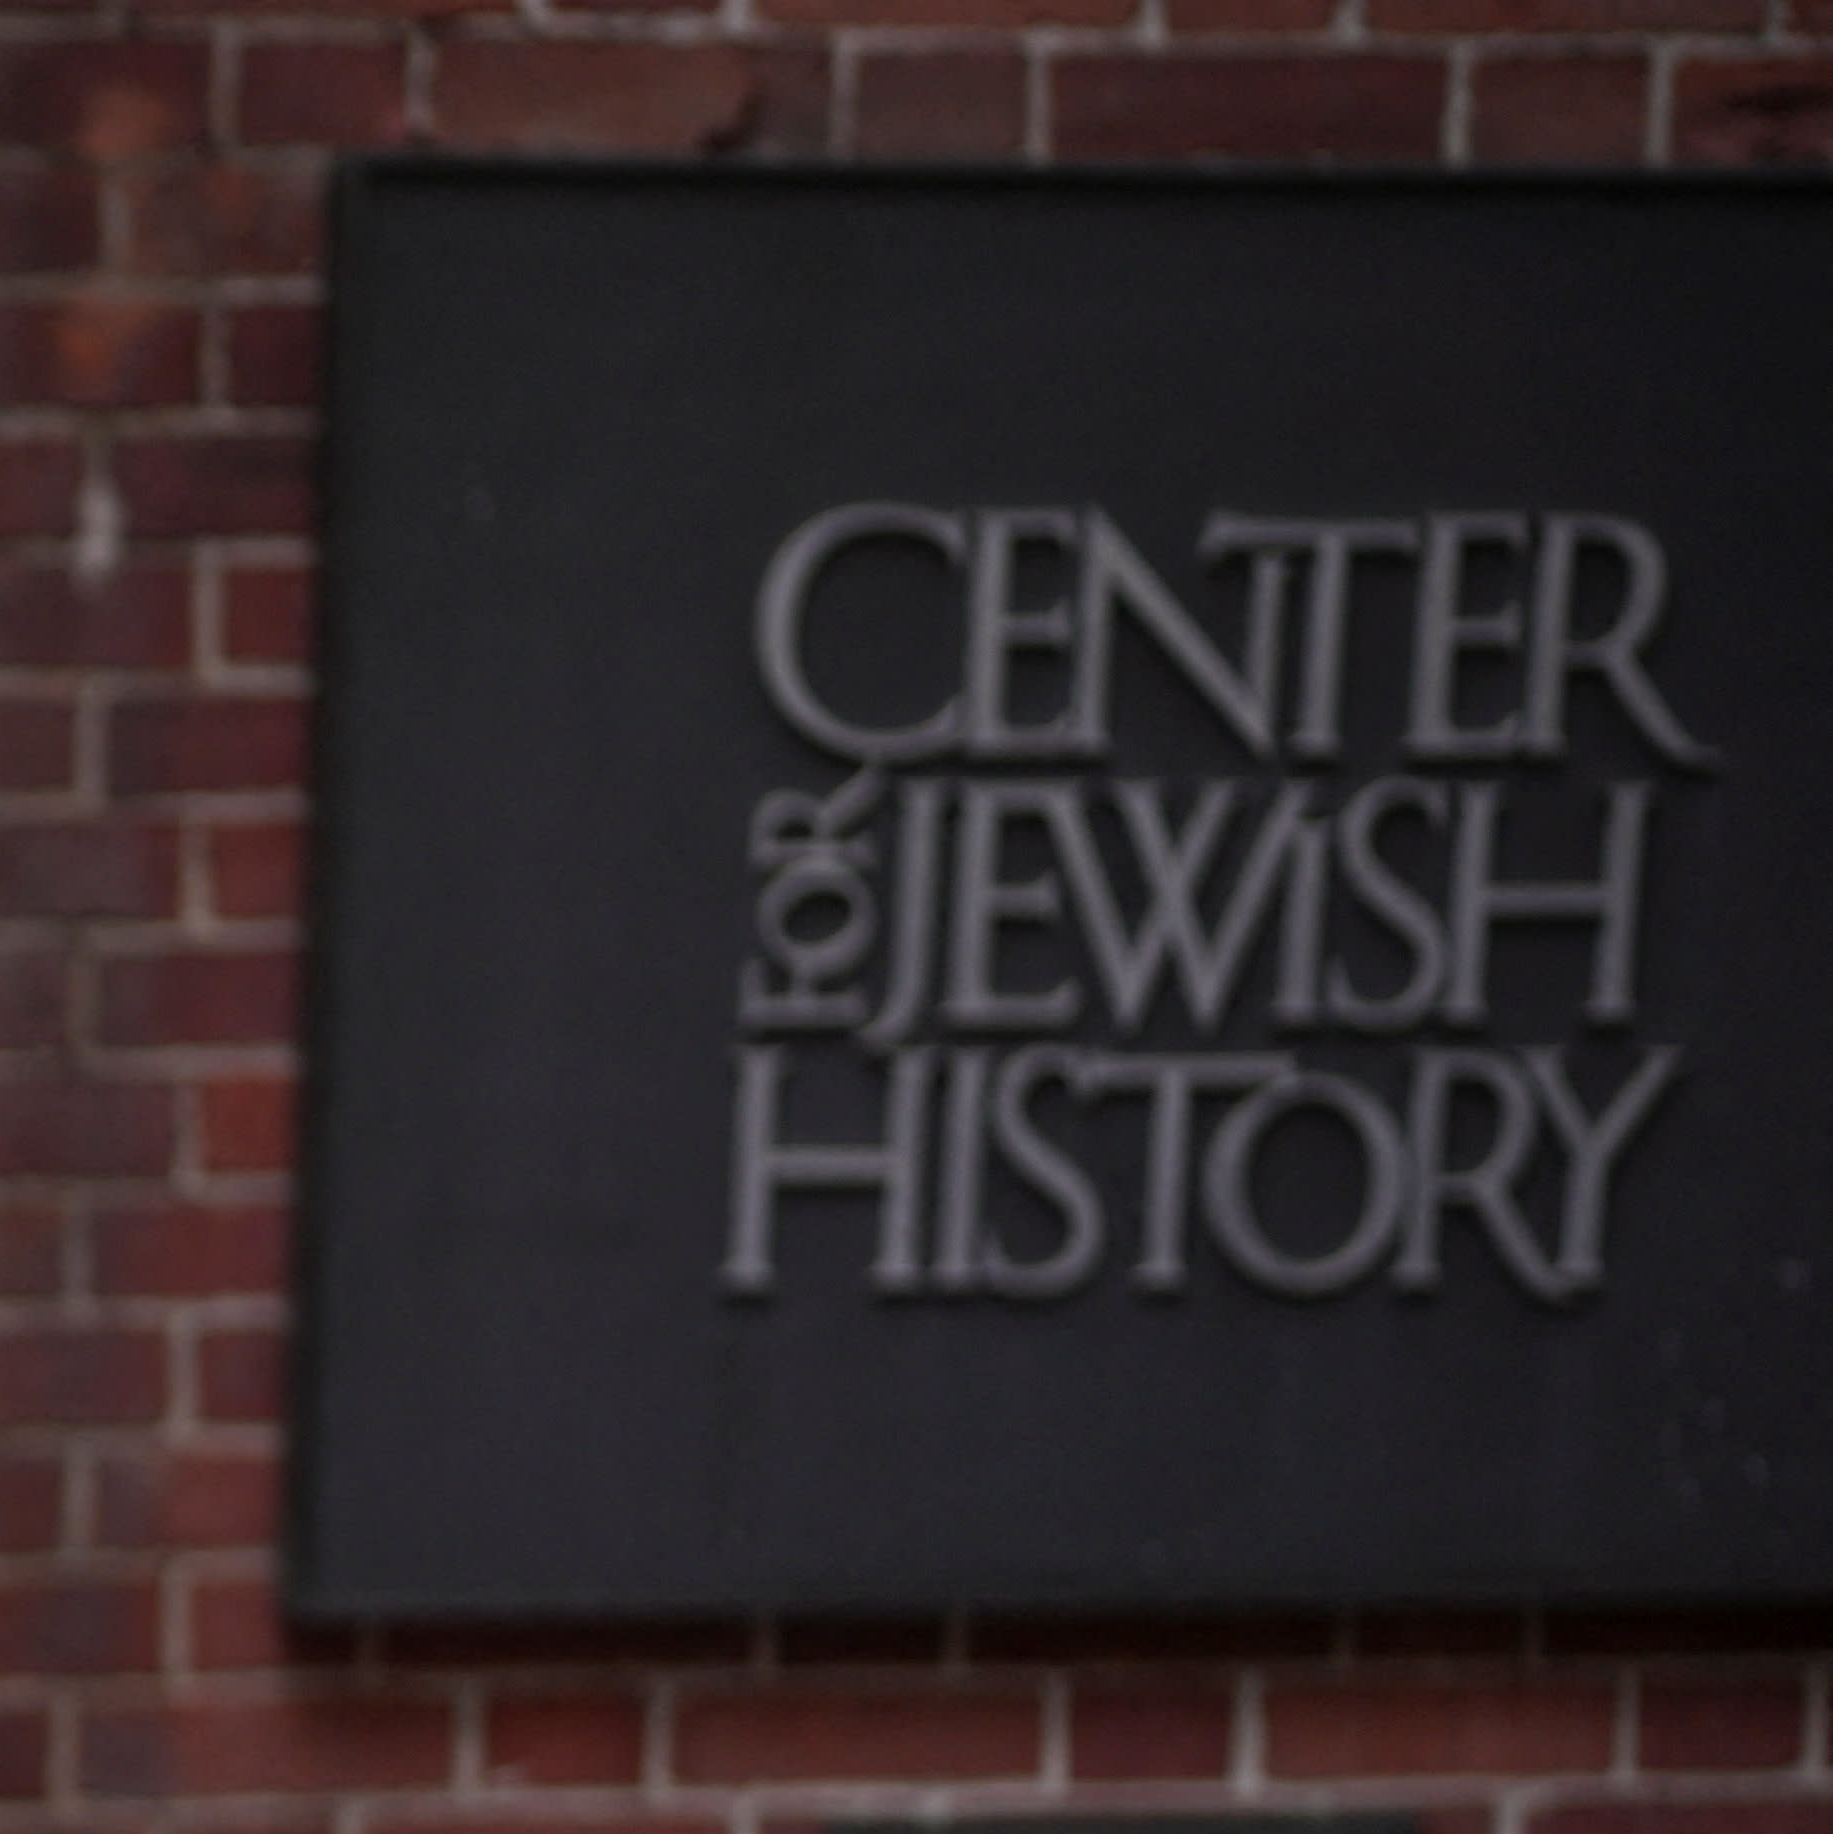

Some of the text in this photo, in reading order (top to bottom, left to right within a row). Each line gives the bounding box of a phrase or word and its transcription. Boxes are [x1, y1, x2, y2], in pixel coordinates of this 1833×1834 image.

[753, 501, 1721, 771] CENTER
[739, 760, 893, 1034] FOR
[856, 775, 1654, 1047] JEWISH
[720, 1043, 1684, 1302] HISTORY
